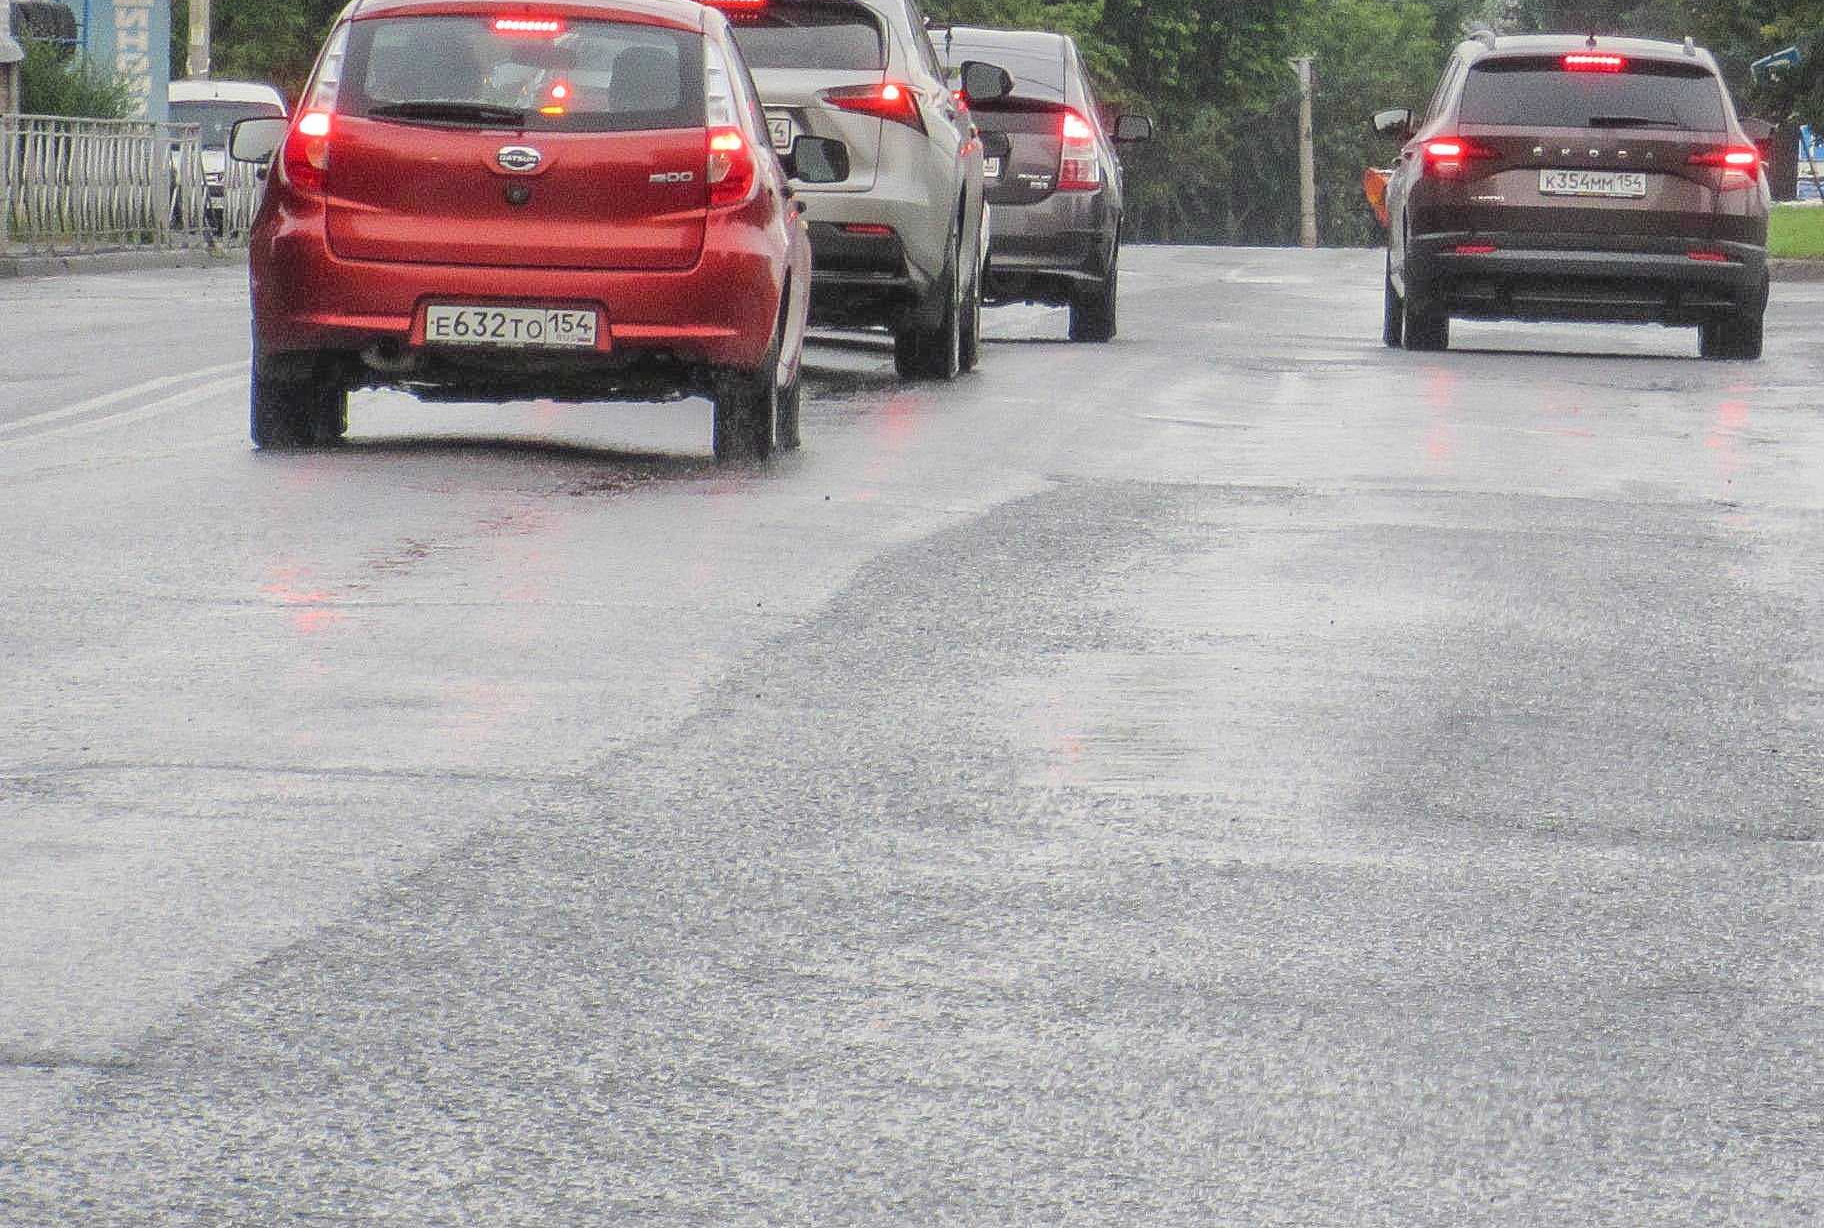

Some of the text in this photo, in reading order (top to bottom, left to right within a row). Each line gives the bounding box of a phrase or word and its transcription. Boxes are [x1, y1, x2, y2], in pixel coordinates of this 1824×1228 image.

[1617, 174, 1642, 189] 154
[436, 310, 590, 339] Е632ТО 154
